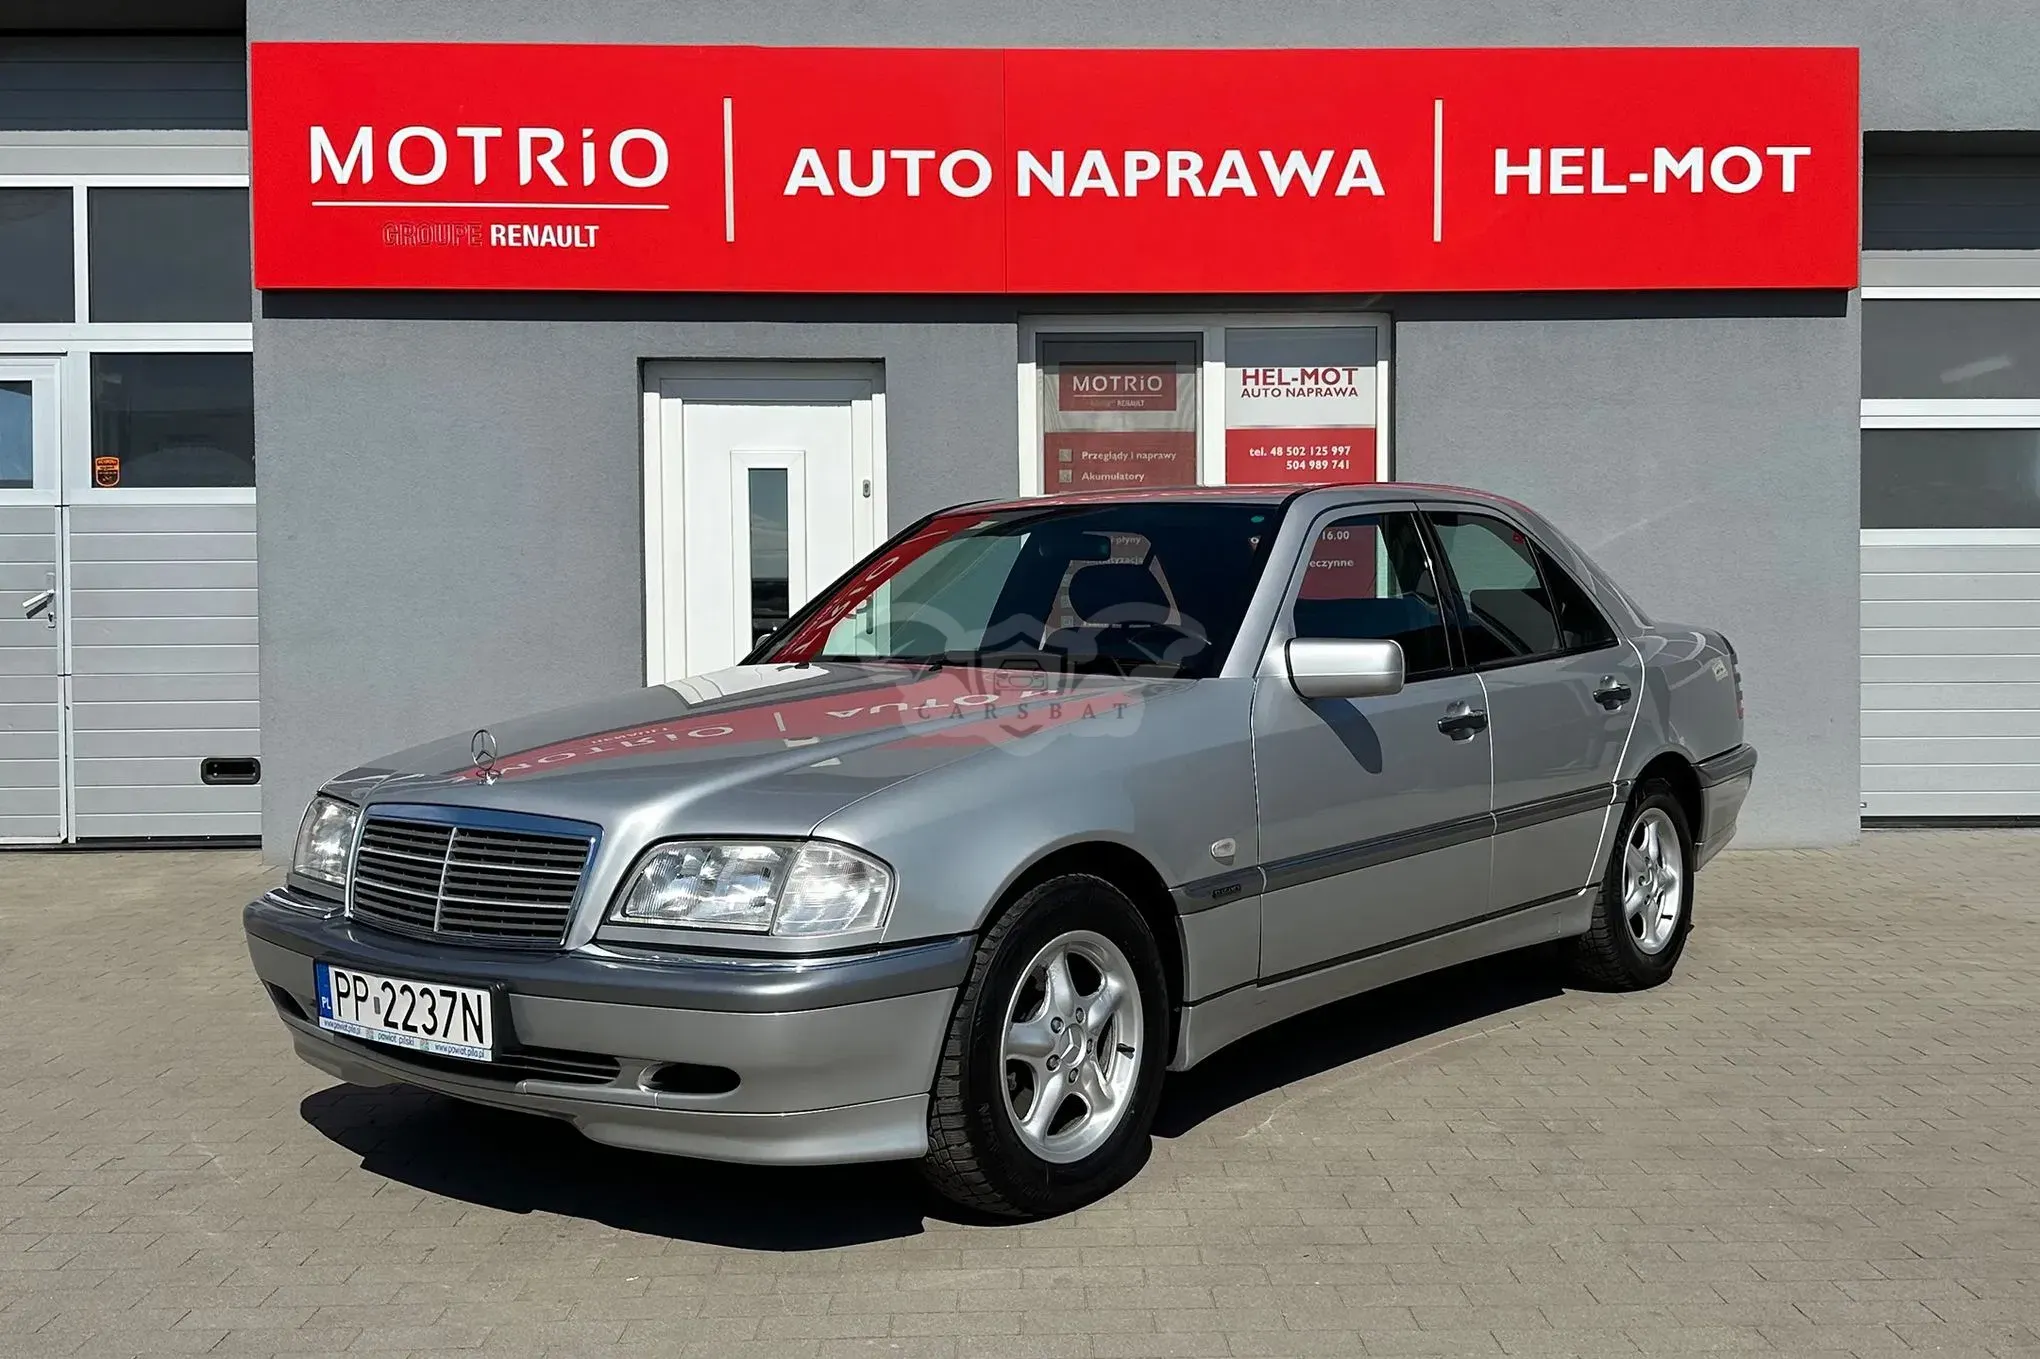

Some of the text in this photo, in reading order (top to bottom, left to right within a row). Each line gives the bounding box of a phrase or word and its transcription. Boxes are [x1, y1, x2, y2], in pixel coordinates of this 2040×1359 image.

[782, 147, 1386, 199] AUTO NAPRAWA
[1494, 145, 1813, 197] HEL-MOT
[490, 224, 600, 248] RENAULT
[1241, 367, 1359, 386] HEL-MOT
[1241, 387, 1359, 398] AUTO NAPRAWA
[1081, 450, 1129, 463] Przeglądy
[1136, 453, 1177, 462] naprawy
[1249, 445, 1351, 457] tel. 48 502 125 997
[1286, 460, 1350, 470] 504 989 741
[1081, 471, 1145, 483] Akumulatory
[321, 996, 332, 1010] PL
[334, 970, 484, 1044] PP 2237N
